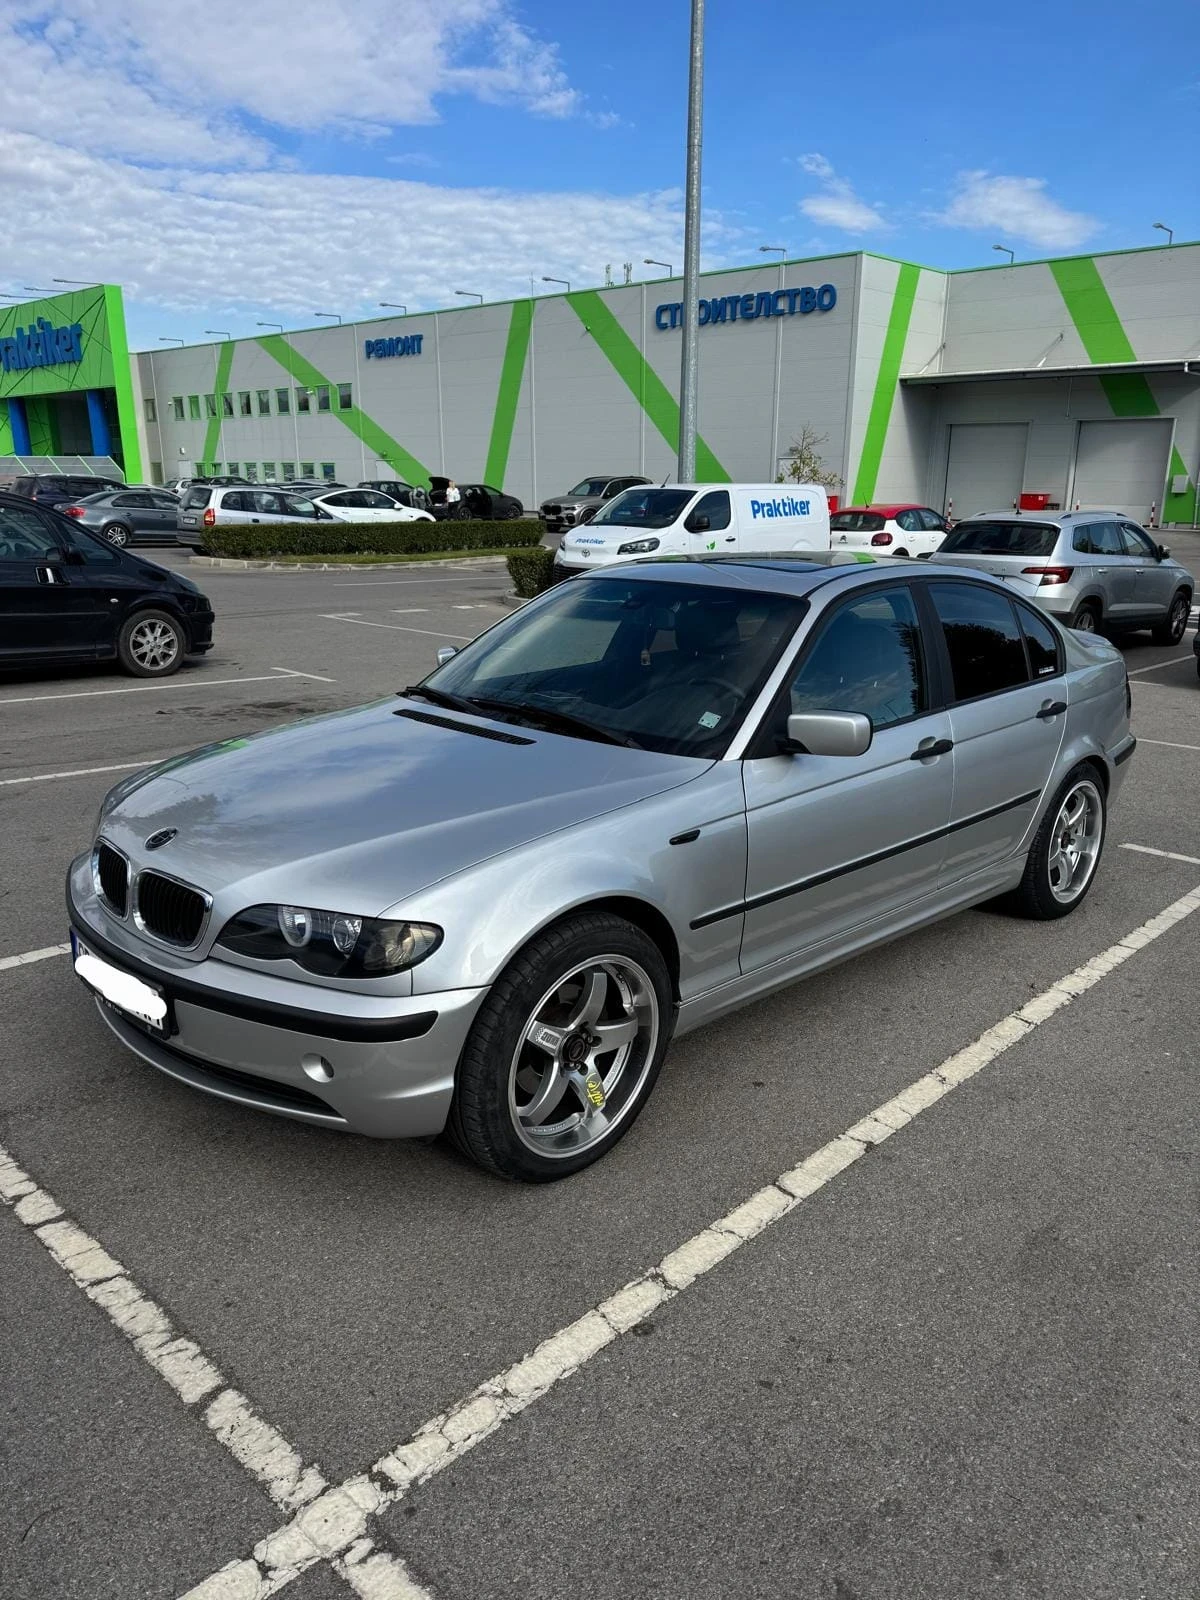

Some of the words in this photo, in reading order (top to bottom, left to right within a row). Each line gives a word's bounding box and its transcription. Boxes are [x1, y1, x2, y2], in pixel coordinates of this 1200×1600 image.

[655, 284, 837, 330] СТОИТЕЛСТВО
[0, 316, 82, 373] raktiker
[750, 496, 810, 519] Praktiker
